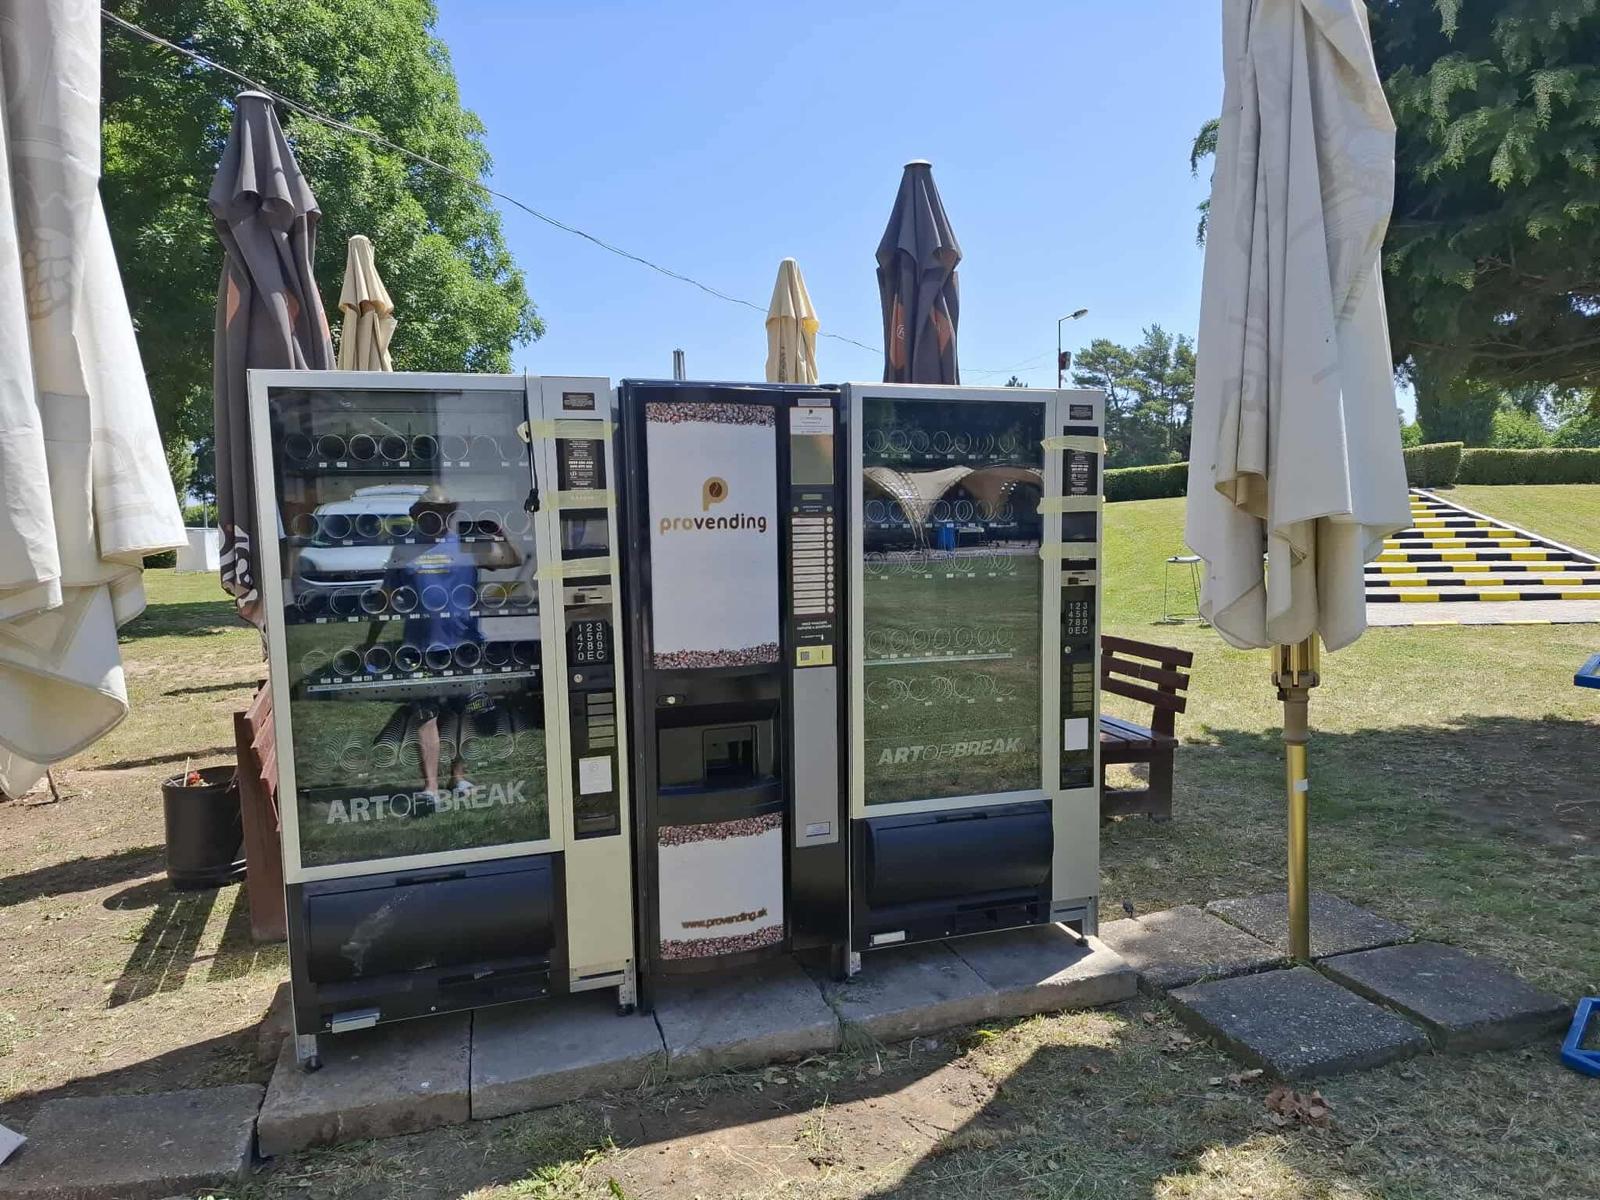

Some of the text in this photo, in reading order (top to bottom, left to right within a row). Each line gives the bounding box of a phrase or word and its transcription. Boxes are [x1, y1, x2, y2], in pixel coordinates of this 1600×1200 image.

[659, 513, 767, 535] provending
[578, 622, 602, 632] 1 2 3
[577, 632, 603, 641] 4 5 6
[577, 641, 603, 651] 7 8 9
[578, 650, 605, 661] 0 E C
